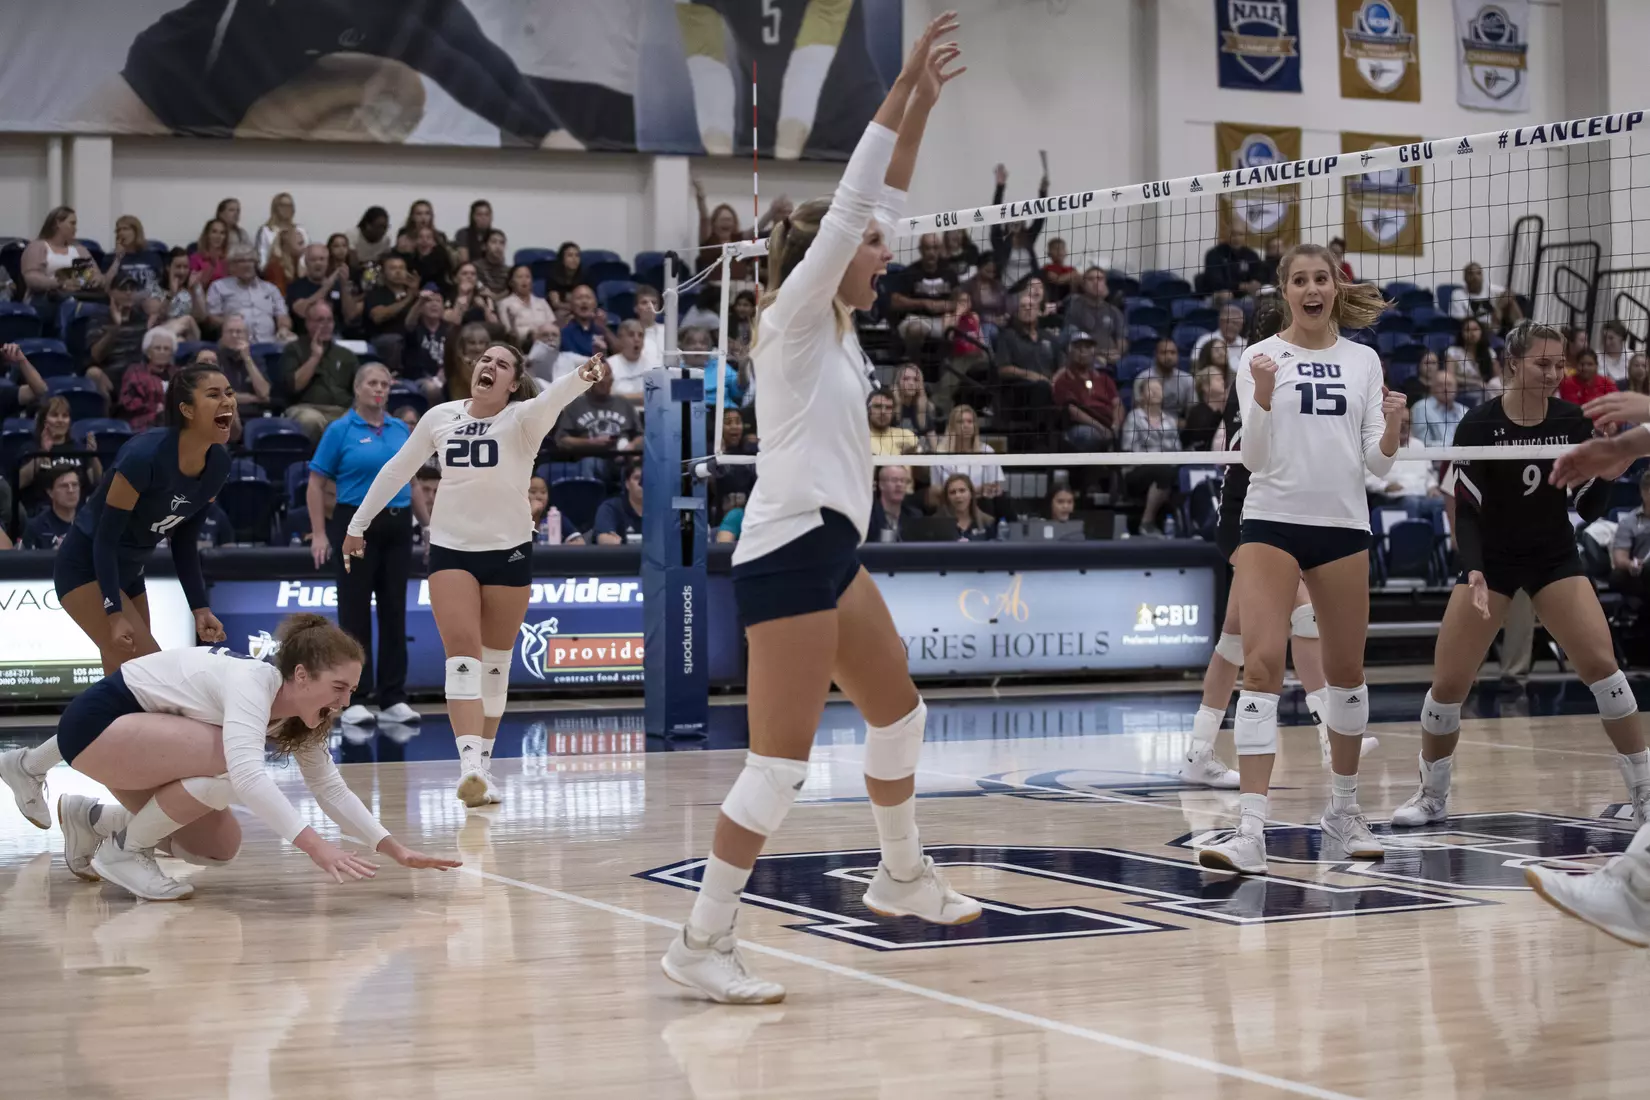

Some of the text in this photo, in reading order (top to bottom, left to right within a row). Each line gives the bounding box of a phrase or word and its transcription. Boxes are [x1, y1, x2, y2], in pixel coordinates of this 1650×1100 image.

[762, 0, 782, 45] 5
[1229, 1, 1287, 30] NAIA
[935, 211, 958, 228] CBU
[1000, 191, 1095, 219] #LANCEUP
[1142, 181, 1171, 199] CBU
[1222, 156, 1338, 188] #LANCEUP
[1399, 142, 1433, 163] CBU
[1498, 111, 1643, 149] #LANCEUP
[1296, 362, 1342, 378] CBU
[1295, 382, 1347, 417] 15
[446, 439, 499, 468] 20
[1522, 464, 1542, 497] 9
[150, 514, 186, 535] 11
[276, 580, 339, 607] Fue
[529, 577, 644, 603] ovider.
[682, 585, 694, 674] sports imports
[1155, 604, 1199, 627] CBU
[900, 631, 1110, 661] YRES HOTELS
[73, 667, 87, 676] LOS
[73, 676, 89, 684] SAN
[554, 674, 594, 684] contract
[597, 672, 619, 683] food
